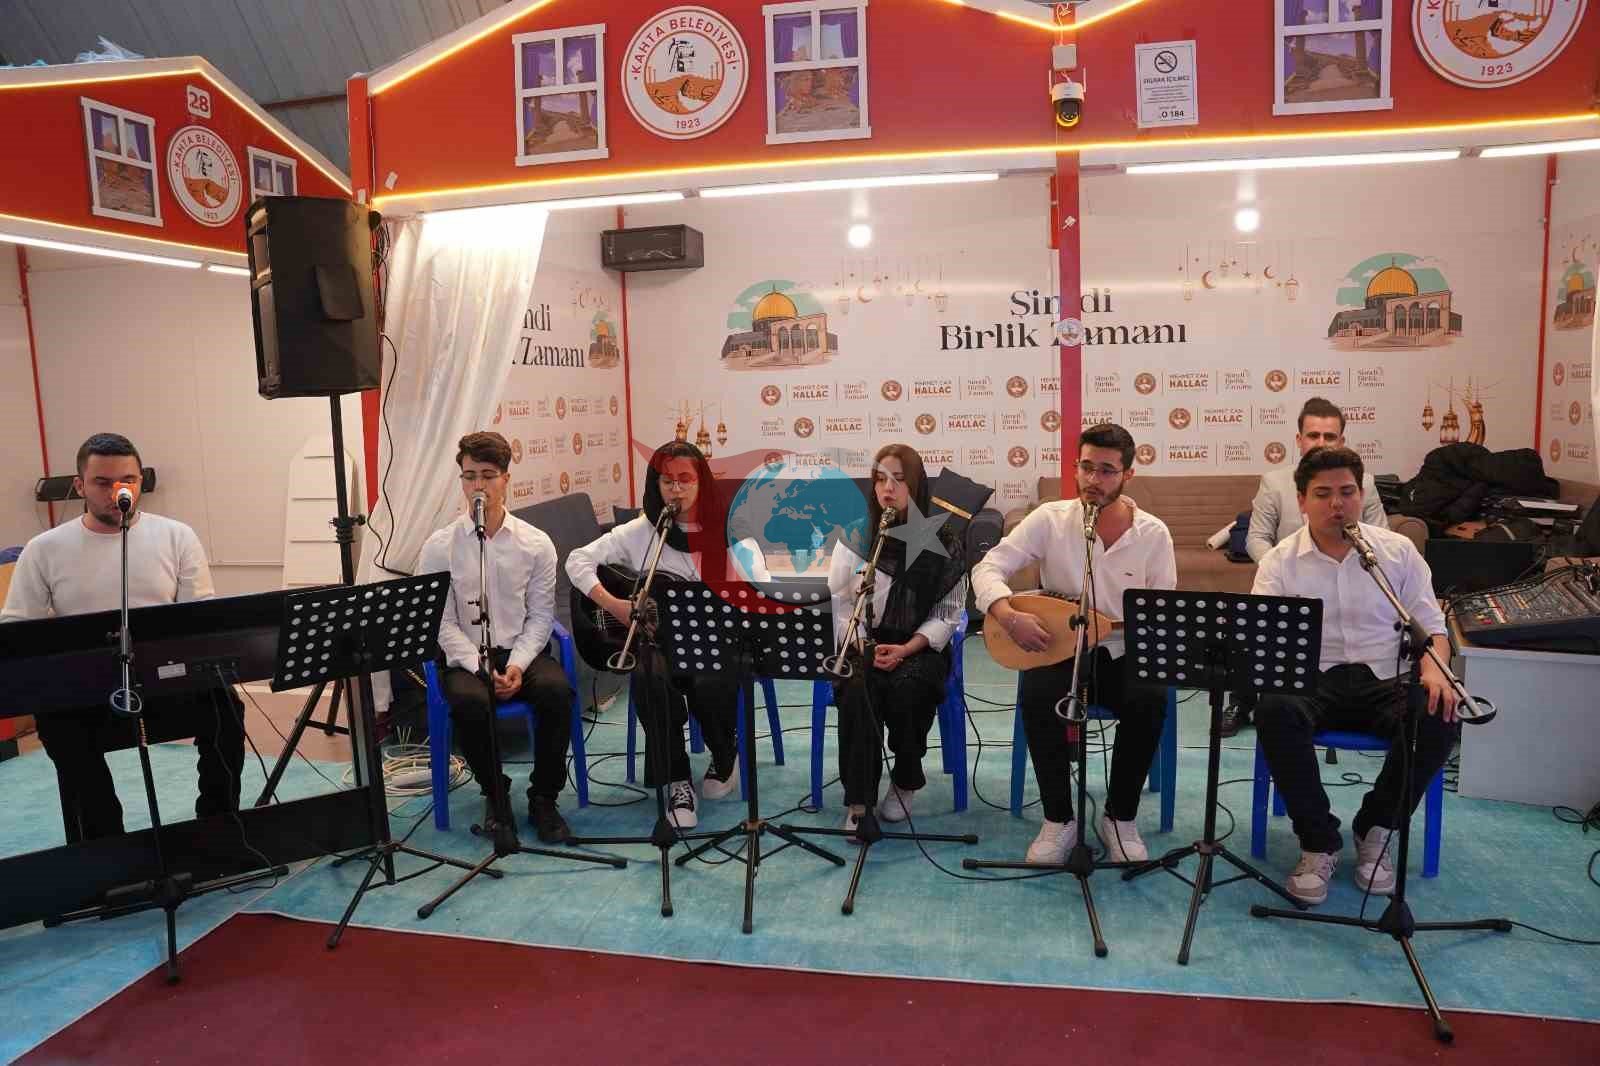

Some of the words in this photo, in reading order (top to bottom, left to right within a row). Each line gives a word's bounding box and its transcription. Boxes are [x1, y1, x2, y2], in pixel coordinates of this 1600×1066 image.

[632, 26, 664, 74] KAHTA
[1480, 62, 1513, 76] 1923
[189, 92, 209, 112] 28
[675, 117, 701, 128] 1923
[940, 323, 1040, 351] Birlik
[520, 336, 585, 368] Zamanı
[1169, 379, 1208, 388] HALLAC
[1301, 376, 1339, 385] HALLAC
[1081, 415, 1112, 425] ALLAC
[1203, 415, 1243, 423] HALLAC
[1343, 412, 1376, 420] ALLAC
[826, 424, 861, 432] HALLAC
[948, 420, 985, 428] HALLAC
[922, 454, 953, 463] ALLAC
[1169, 450, 1208, 459] HALLAC
